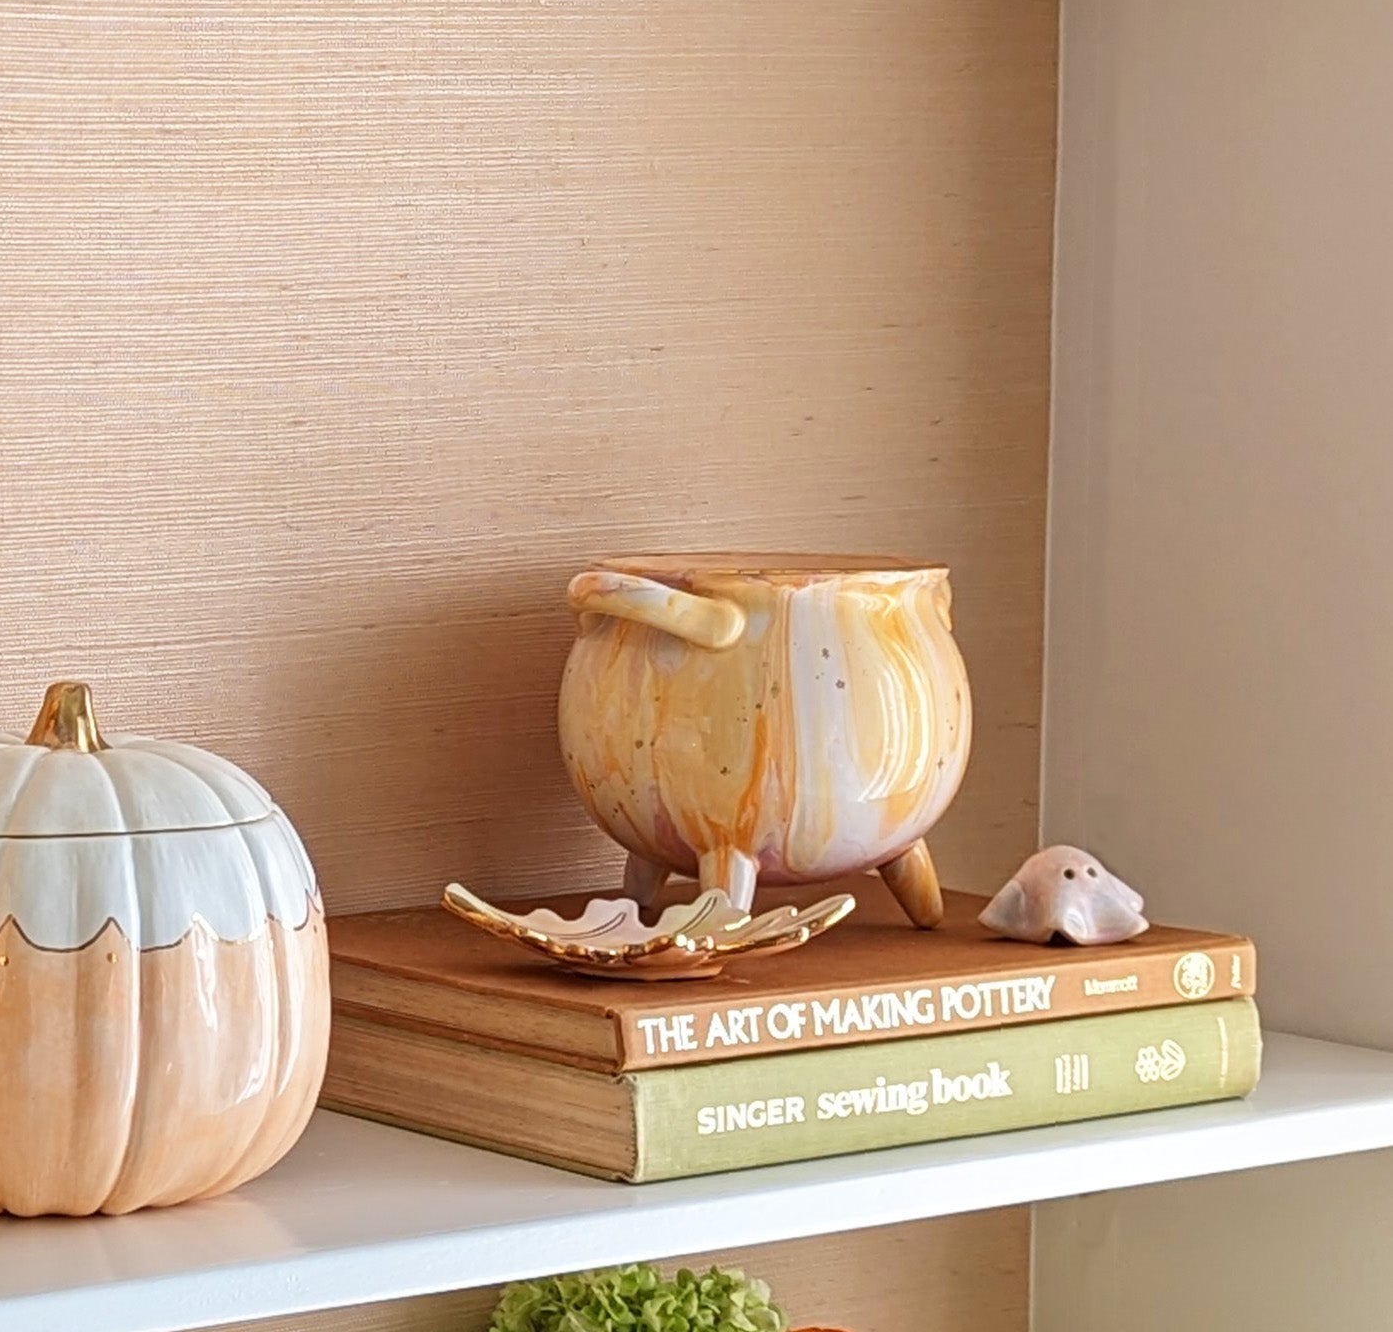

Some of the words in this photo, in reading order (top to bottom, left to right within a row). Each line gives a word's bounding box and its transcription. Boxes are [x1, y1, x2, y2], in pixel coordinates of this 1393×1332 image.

[637, 1013, 698, 1056] THE
[705, 1005, 765, 1048] ART
[767, 1001, 807, 1040] OF
[810, 988, 934, 1036] MAKING
[940, 974, 1056, 1021] POTTERY
[696, 1095, 806, 1135] SINGER
[816, 1075, 929, 1120] sewing
[931, 1061, 1013, 1105] book
